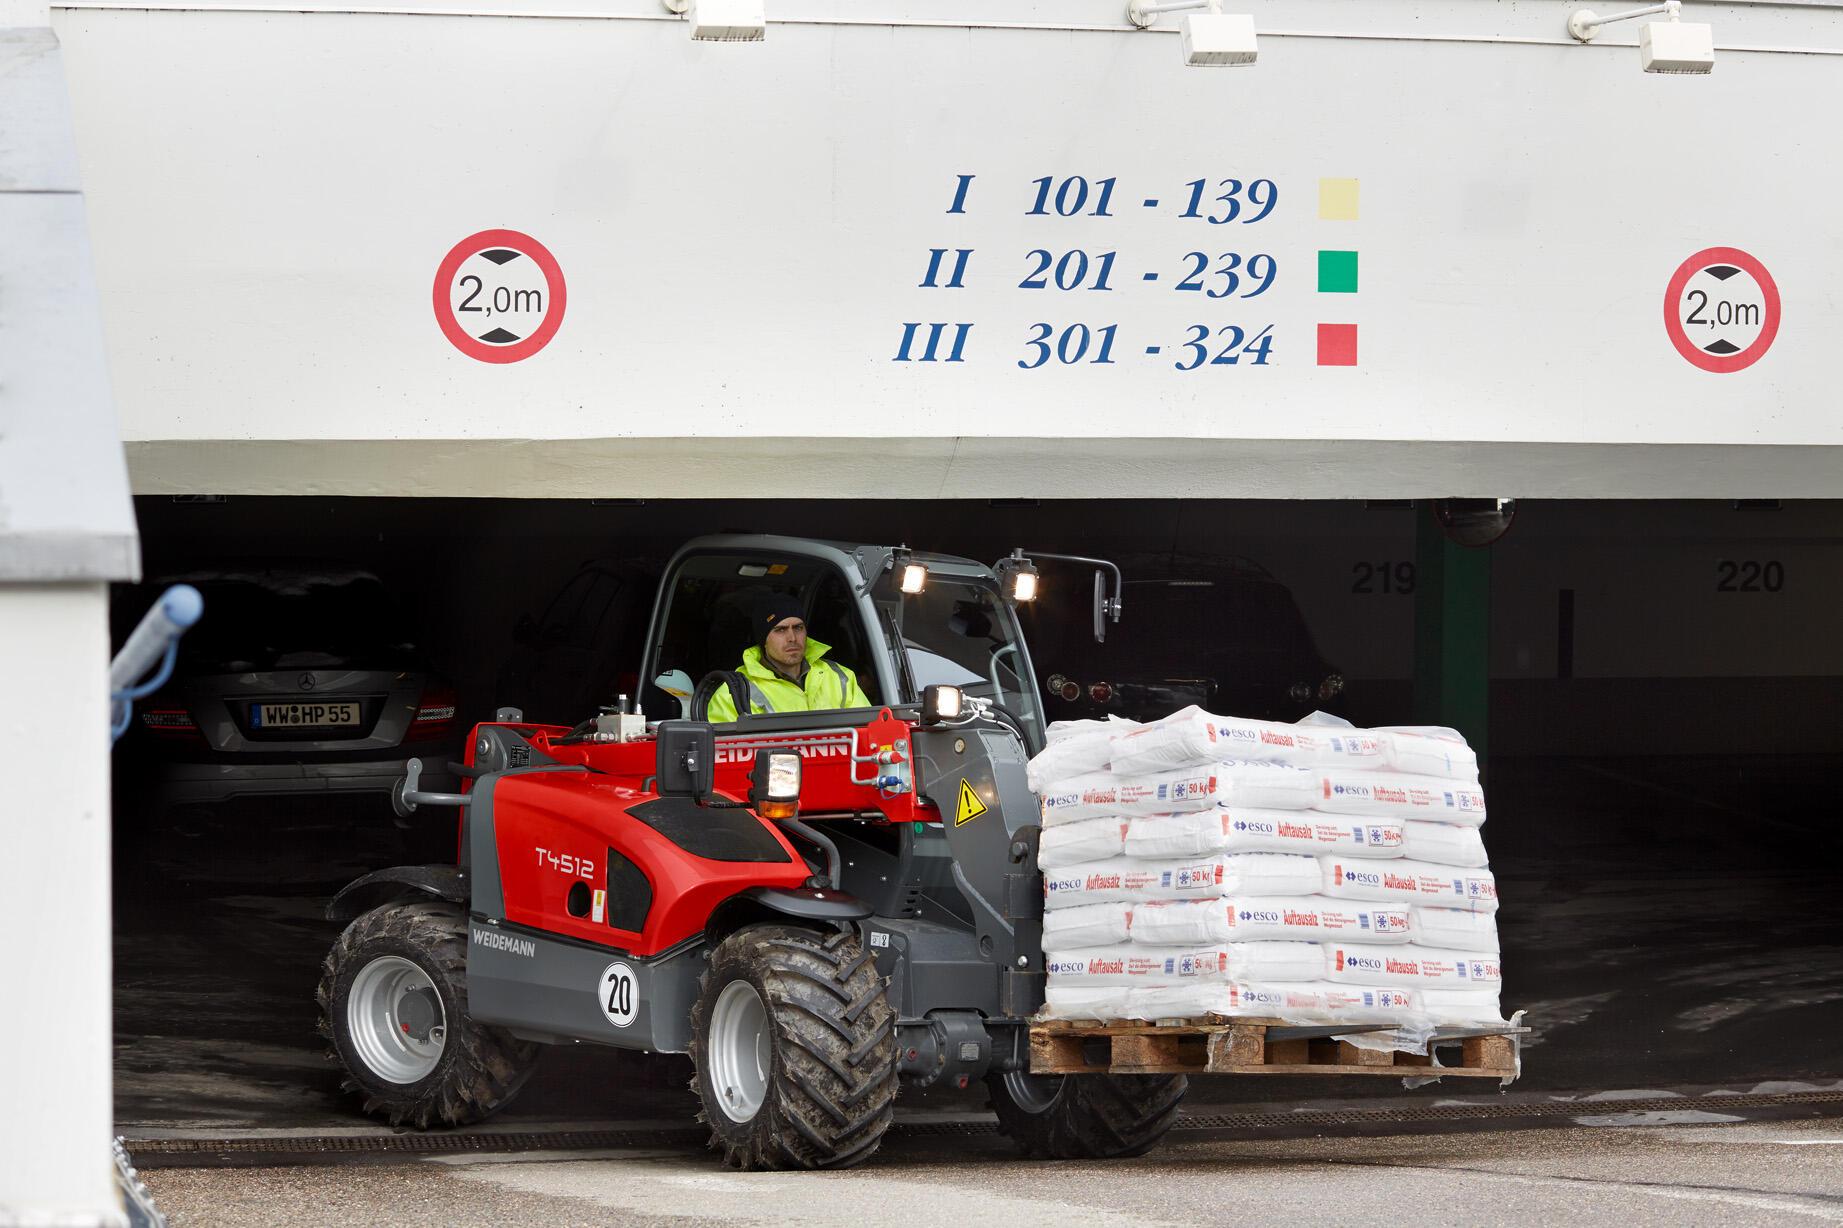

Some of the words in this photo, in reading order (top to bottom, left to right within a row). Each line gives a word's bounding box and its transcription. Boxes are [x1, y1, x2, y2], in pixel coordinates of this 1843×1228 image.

[945, 174, 976, 214] I
[1024, 175, 1117, 217] 101
[1178, 178, 1278, 224] 139
[918, 248, 975, 288] II
[1018, 249, 1117, 291] 201
[1174, 251, 1277, 299] 239
[458, 275, 542, 318] 2,0m
[1685, 289, 1759, 330] 2,0m
[892, 322, 975, 362] III
[1018, 323, 1118, 370] 301
[1175, 324, 1275, 371] 324
[1352, 561, 1416, 594] 219
[1717, 560, 1784, 592] 220
[265, 706, 290, 724] WW
[301, 706, 326, 724] HP
[328, 705, 352, 723] 55
[1231, 728, 1256, 740] esco
[1056, 794, 1079, 806] esco
[1188, 783, 1198, 794] 50
[1345, 786, 1369, 796] esco
[1248, 821, 1273, 833] esco
[1383, 830, 1392, 841] 50
[535, 847, 595, 880] T4512
[1059, 879, 1082, 890] esco
[1085, 873, 1121, 891] Auftausalz
[1192, 871, 1201, 882] 50
[1357, 872, 1379, 884] esco
[1253, 911, 1278, 922] esco
[1389, 916, 1398, 927] 50
[473, 928, 536, 958] WEIDEMANN
[1060, 962, 1084, 972] esco
[1088, 958, 1124, 975] Auftausalz
[1359, 957, 1382, 969] esco
[608, 973, 631, 1016] 20
[1394, 994, 1403, 1005] 50
